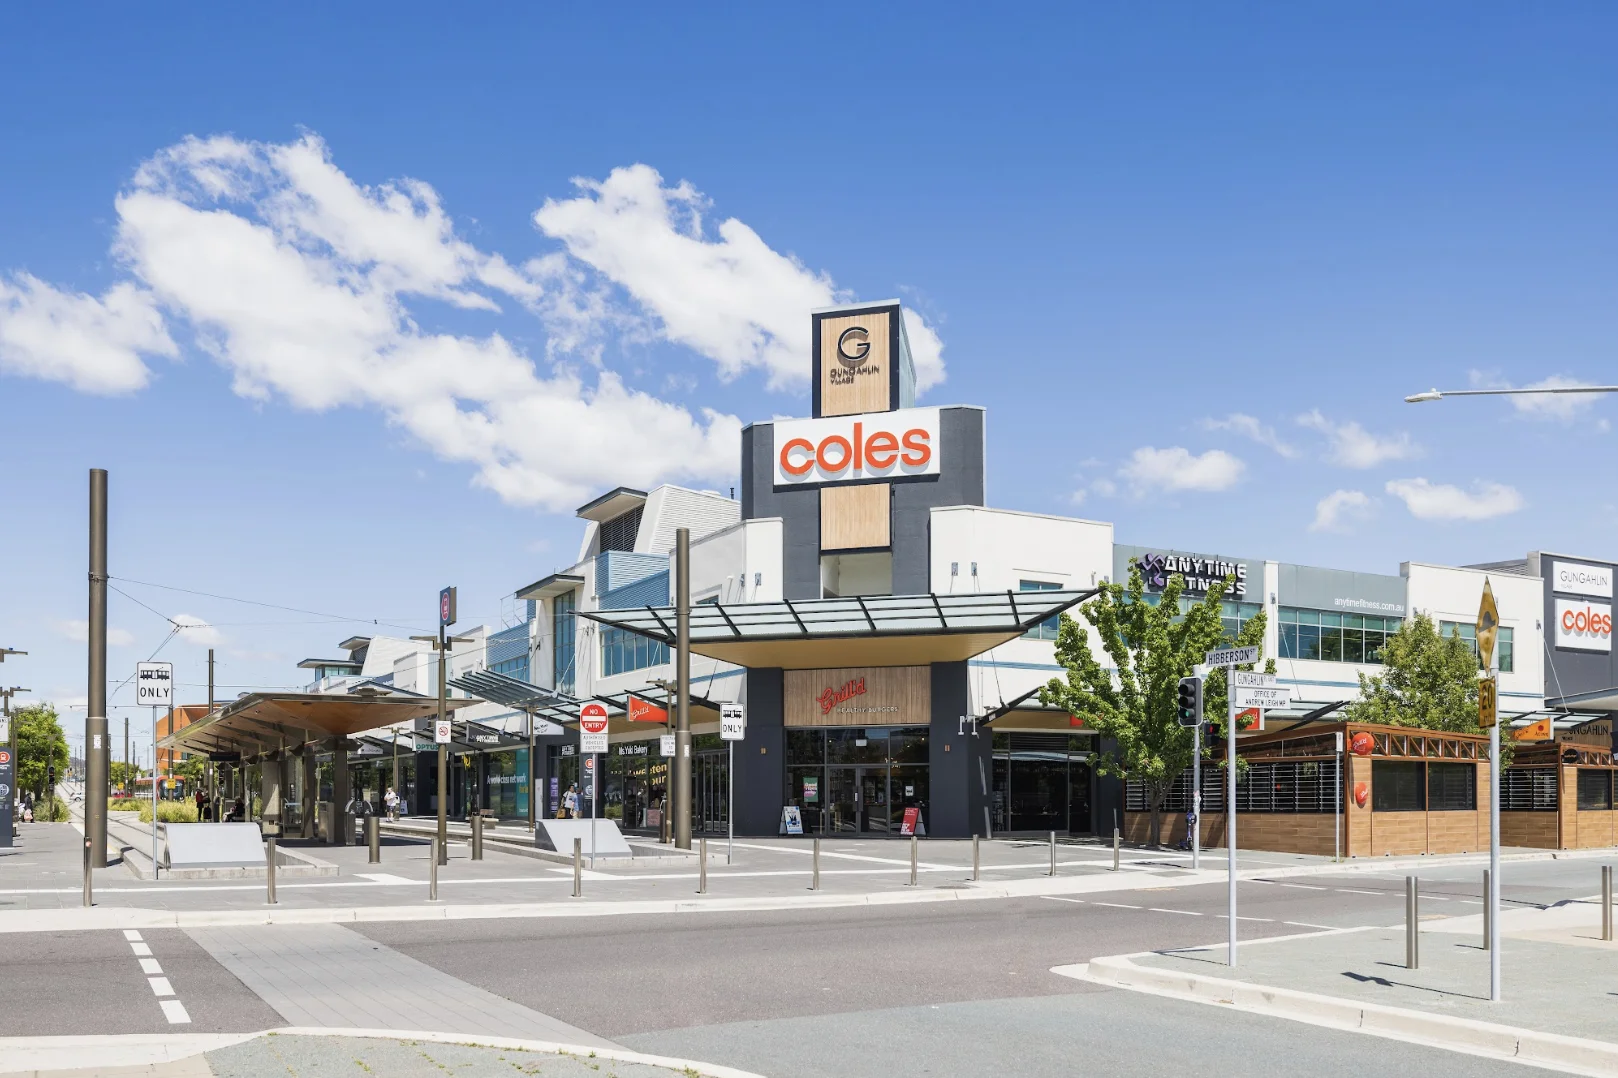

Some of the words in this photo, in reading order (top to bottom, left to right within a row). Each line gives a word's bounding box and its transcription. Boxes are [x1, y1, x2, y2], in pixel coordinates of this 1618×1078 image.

[830, 365, 879, 378] GUNGAHLIN
[780, 422, 931, 476] coles
[1165, 555, 1247, 579] ANYTIME
[1167, 575, 1247, 595] FTNESS
[1560, 570, 1608, 586] GUNGAHLIN
[1334, 597, 1404, 612] anytimefitness.com.au
[1562, 606, 1613, 634] coles
[1208, 649, 1250, 665] HIBBERSON
[1237, 673, 1264, 686] GUNGAHLIN
[140, 687, 170, 698] ONLY
[815, 677, 867, 715] Grill'd
[1254, 690, 1269, 698] OFFICE
[1482, 684, 1492, 710] 20
[1245, 698, 1264, 707] ANDREW
[1265, 699, 1278, 707] LEIGH
[723, 724, 742, 733] ONLY
[1563, 724, 1609, 736] UNGAHLIN
[634, 745, 648, 754] Bakery
